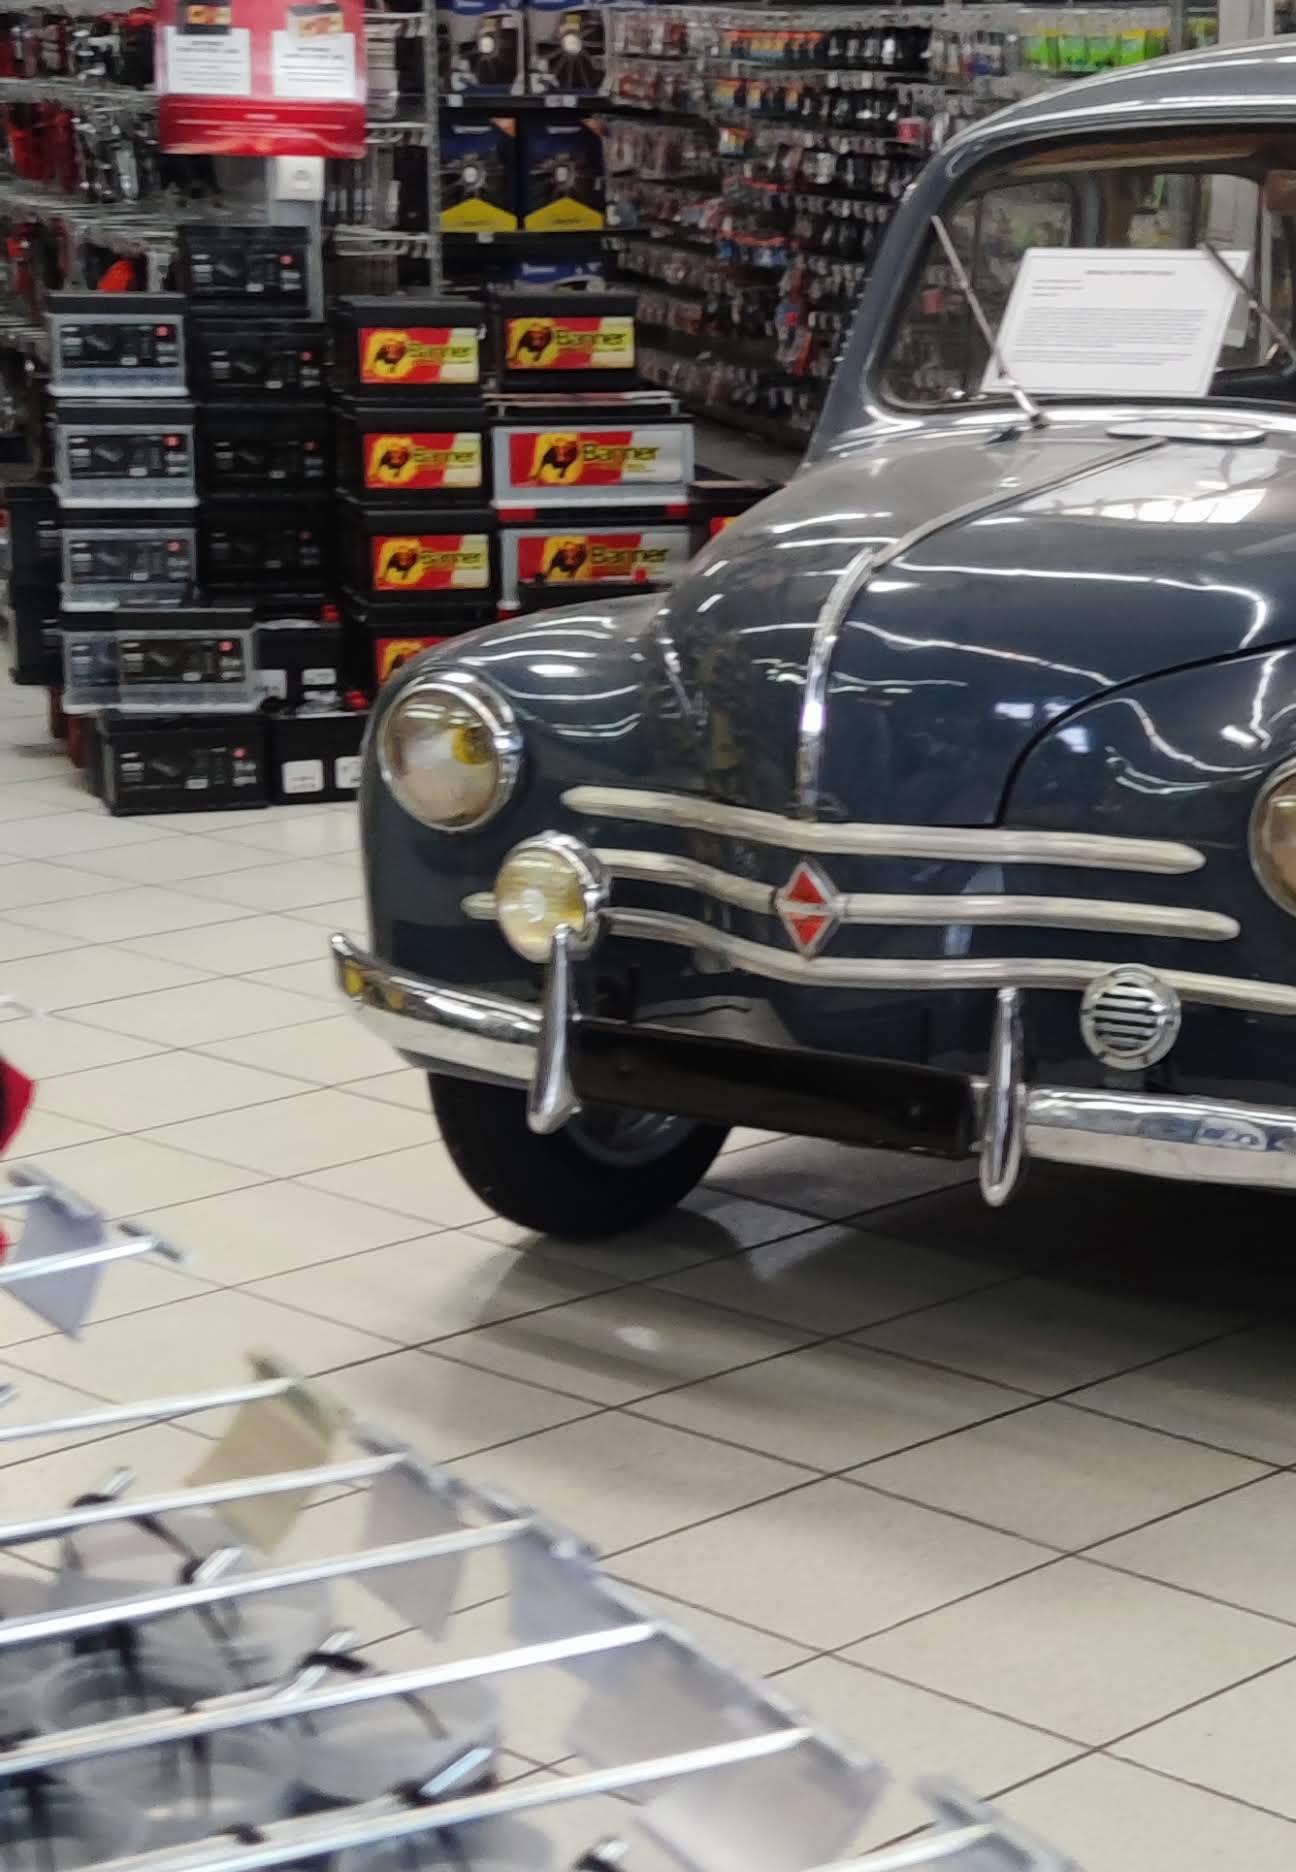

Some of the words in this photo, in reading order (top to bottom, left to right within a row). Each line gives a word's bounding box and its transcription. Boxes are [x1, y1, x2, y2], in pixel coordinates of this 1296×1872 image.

[554, 329, 626, 348] Banner
[582, 443, 660, 463] Banner
[591, 546, 670, 566] Banner
